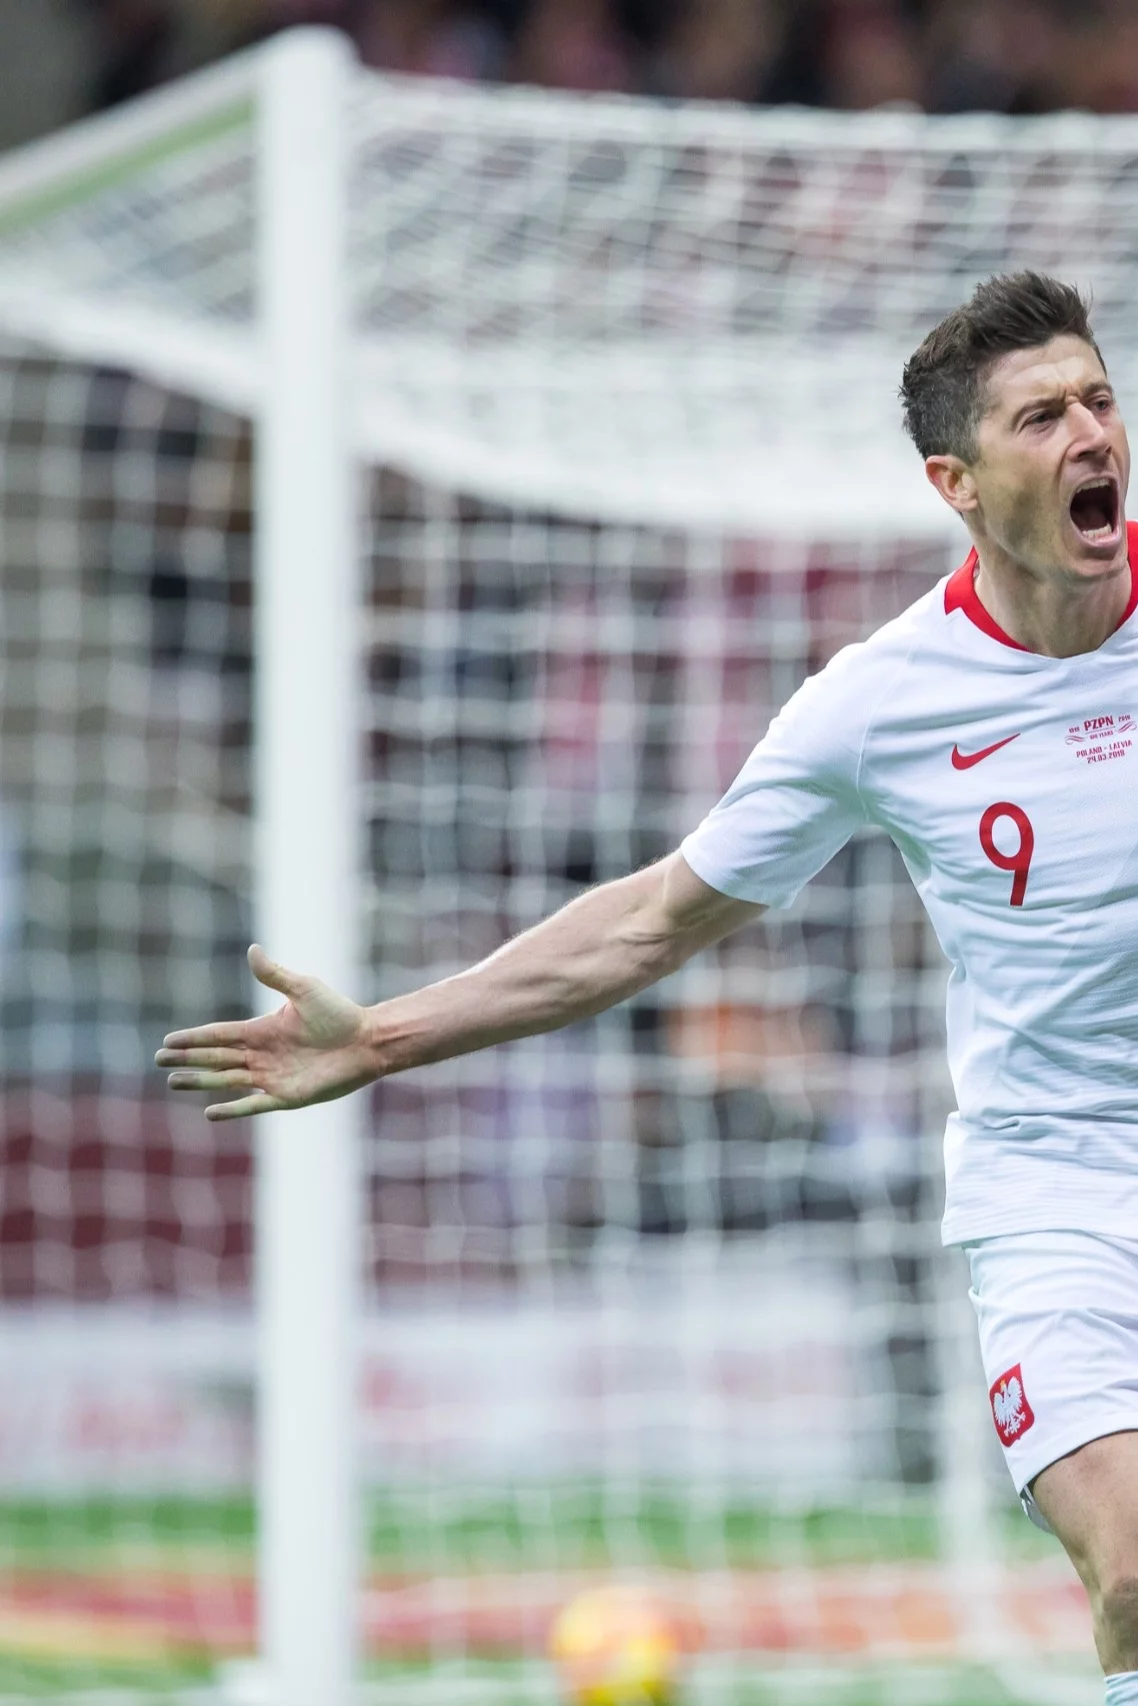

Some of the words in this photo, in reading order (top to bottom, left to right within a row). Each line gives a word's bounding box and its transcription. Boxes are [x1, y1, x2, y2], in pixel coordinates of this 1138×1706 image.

[1083, 715, 1114, 731] PZPN
[1099, 730, 1114, 738] YEARS
[1076, 746, 1103, 758] POLAND
[1109, 740, 1132, 751] LATVIA
[979, 801, 1034, 907] 9
